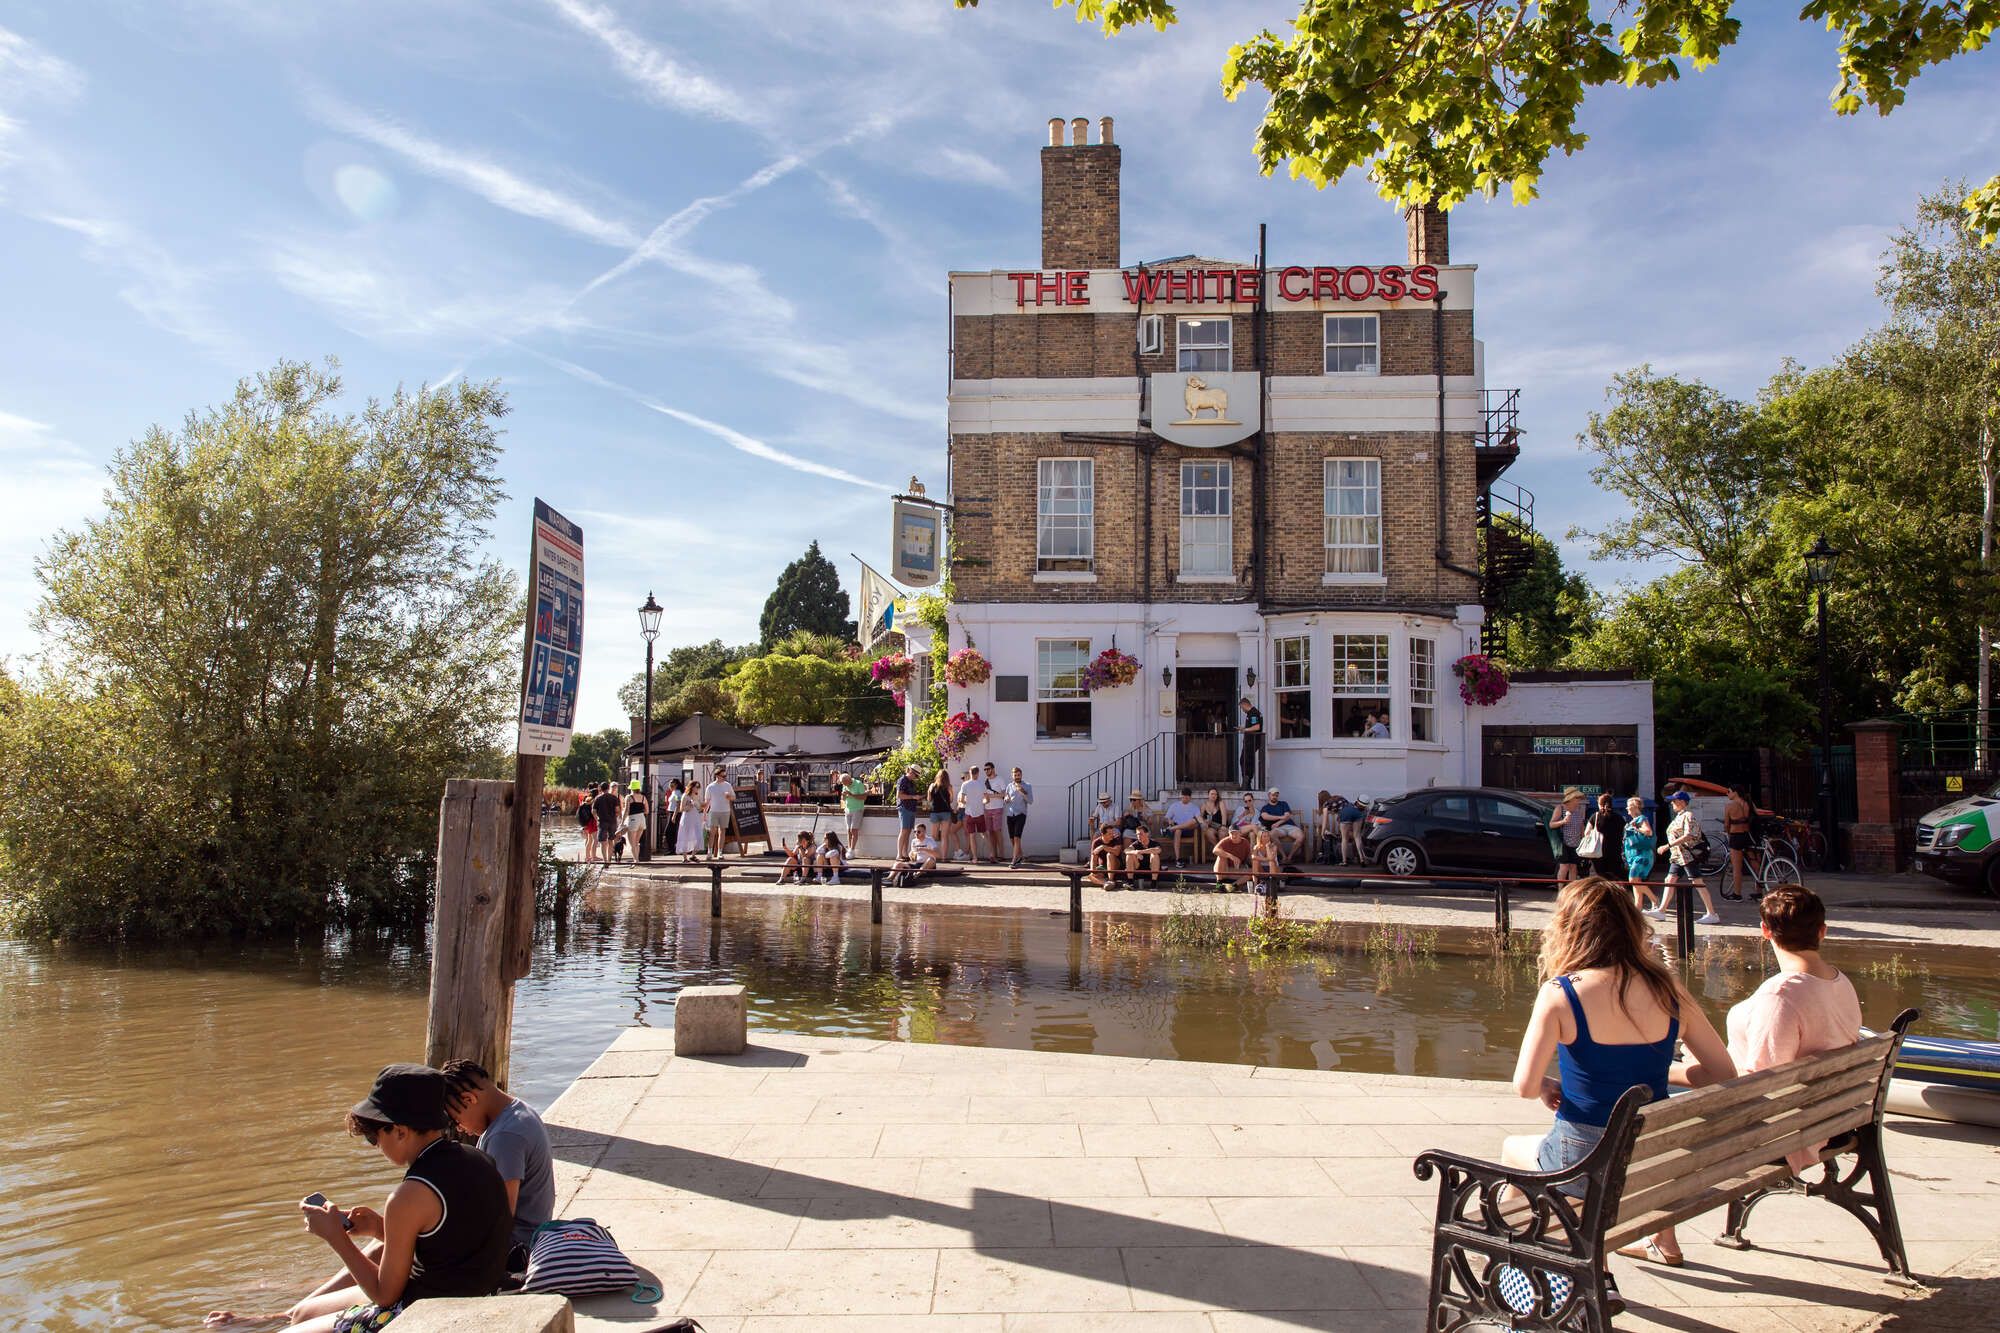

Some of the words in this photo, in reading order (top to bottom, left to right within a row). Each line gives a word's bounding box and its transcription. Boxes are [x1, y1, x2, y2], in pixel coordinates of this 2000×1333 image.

[1007, 270, 1090, 307] THE
[1122, 268, 1261, 305] WHITE
[1279, 264, 1439, 302] CROSS
[547, 508, 572, 537] WARNING
[544, 547, 556, 562] WATER
[556, 553, 570, 570] SAFETY
[570, 562, 579, 576] TIPS
[540, 571, 554, 587] LIFE
[734, 801, 757, 809] TAKEAWAY
